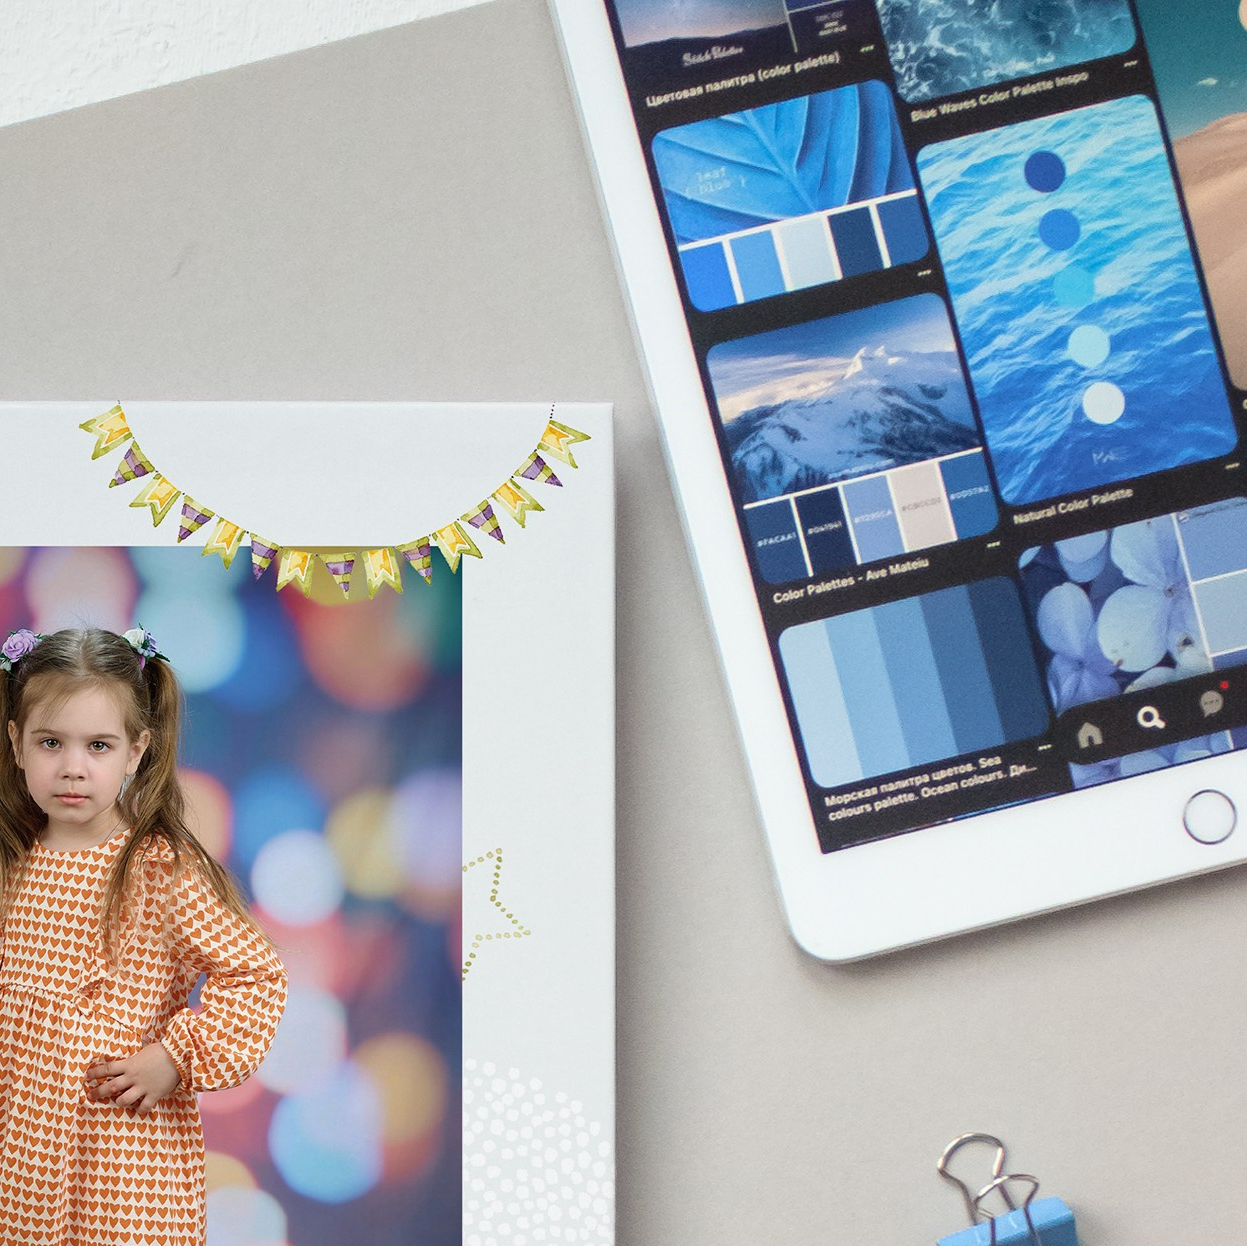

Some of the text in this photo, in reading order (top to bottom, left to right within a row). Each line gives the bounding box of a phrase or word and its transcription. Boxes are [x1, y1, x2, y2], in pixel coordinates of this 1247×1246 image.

[646, 51, 840, 107] Цветовая палитра (color palette)
[911, 108, 937, 122] Blue
[939, 98, 977, 115] Waves
[979, 90, 1011, 105] Color
[1012, 79, 1053, 98] Palette
[1013, 488, 1134, 524] Natural Color Palette
[773, 588, 805, 603] Color
[806, 576, 855, 595] Palettes
[866, 569, 888, 581] Ave
[825, 755, 1002, 807] Морская палитра цветов. Sea
[829, 804, 872, 821] colours
[874, 791, 919, 812] palette.
[921, 782, 959, 798] Ocean
[960, 771, 1008, 788] colours.
